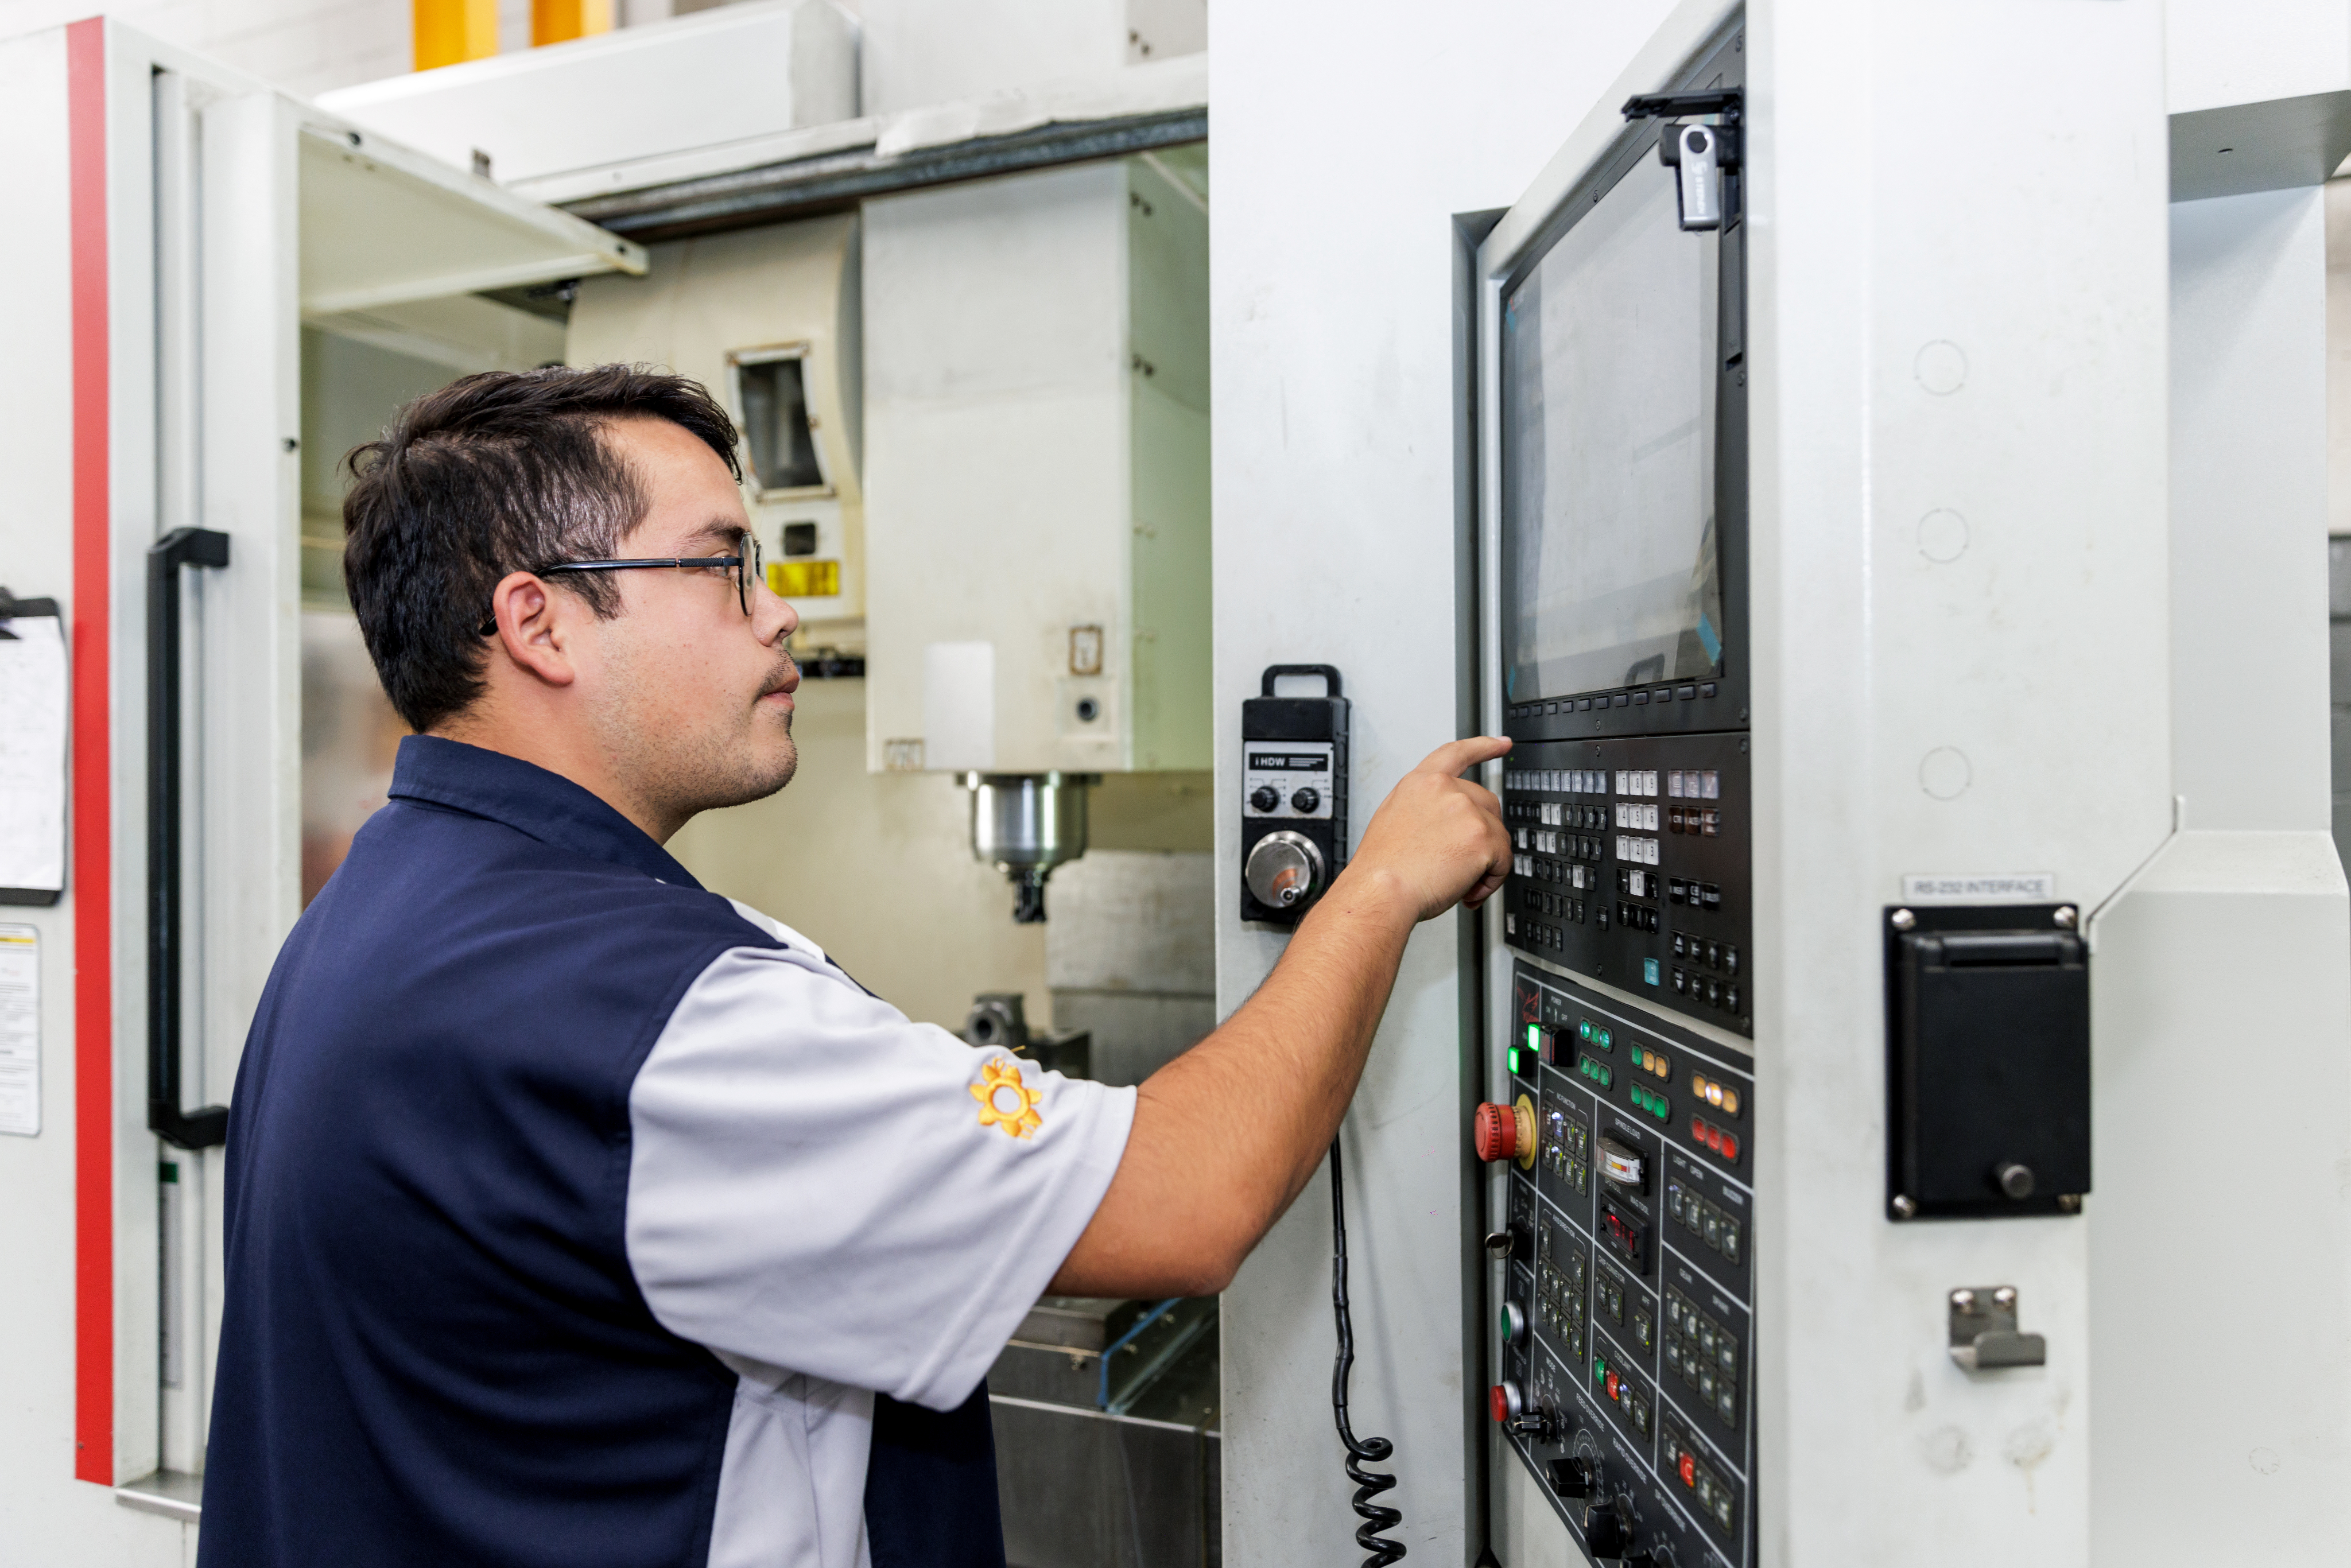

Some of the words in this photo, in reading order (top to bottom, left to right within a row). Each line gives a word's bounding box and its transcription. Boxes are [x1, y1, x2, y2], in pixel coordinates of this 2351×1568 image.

[1261, 758, 1286, 767] HDW
[1915, 879, 1962, 894] RS-232
[1967, 879, 2045, 894] INTERFACE
[1551, 996, 1562, 1006] POWER
[1615, 1118, 1630, 1134] SPINDLE
[1630, 1127, 1640, 1139] LOAD
[1598, 1255, 1606, 1267] CHIP
[1546, 1356, 1556, 1373] MODE
[1614, 1350, 1632, 1372] COOLANT
[1576, 1392, 1586, 1410] FEED
[1586, 1404, 1605, 1433] OVERRIDE
